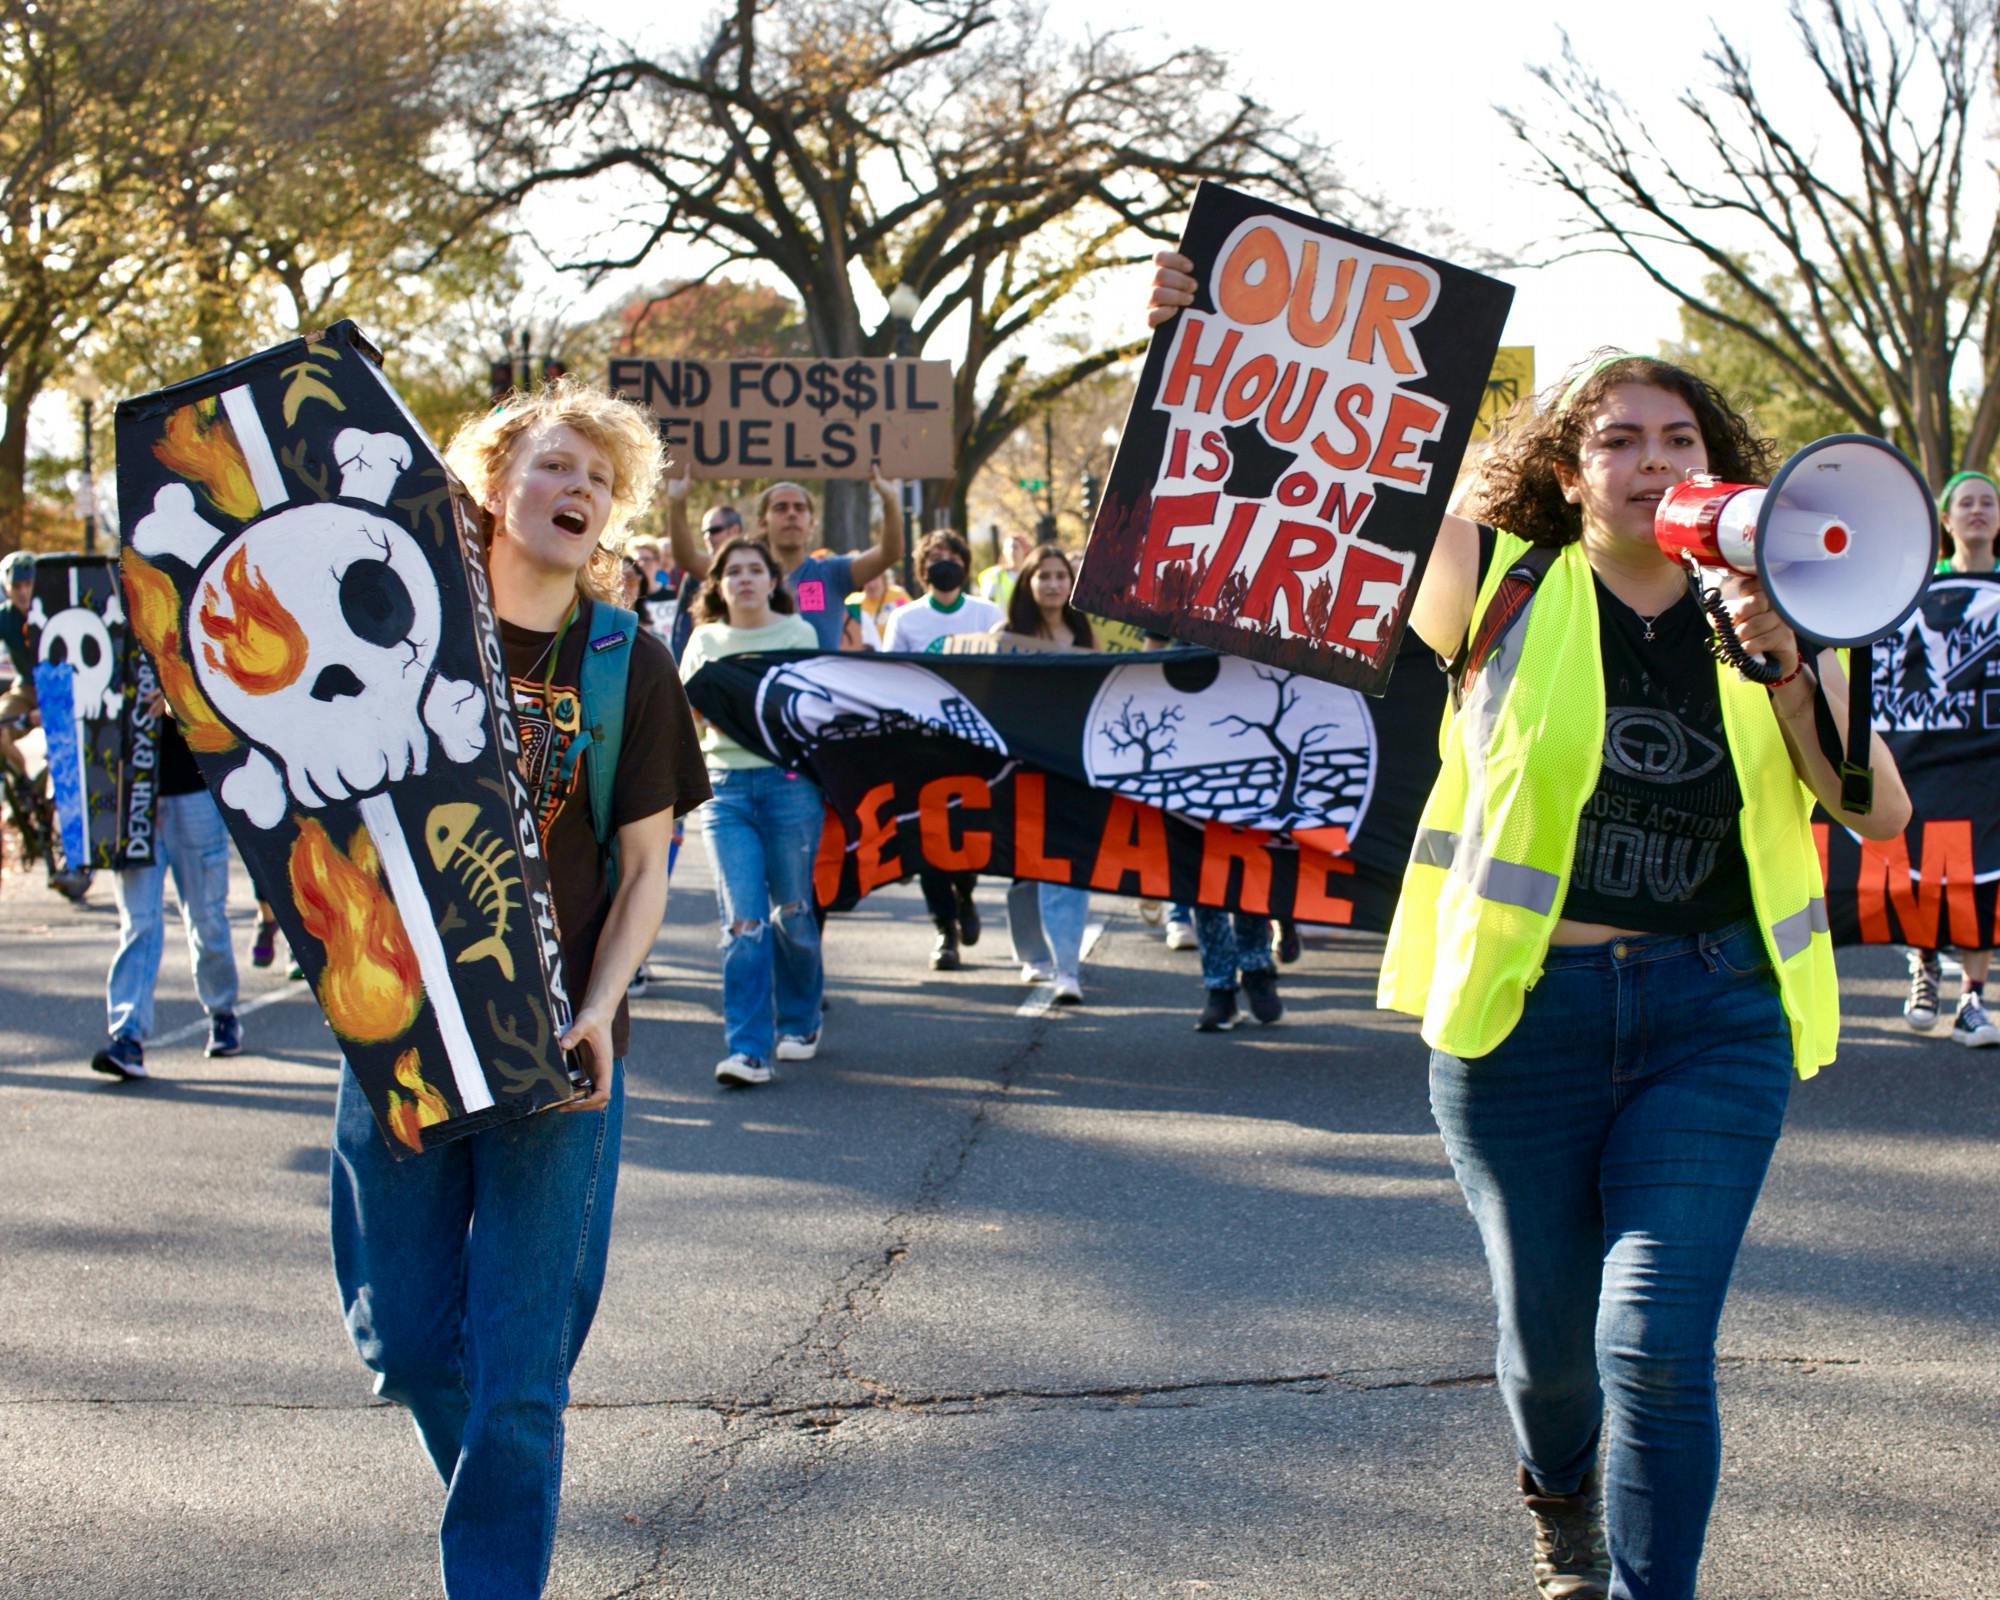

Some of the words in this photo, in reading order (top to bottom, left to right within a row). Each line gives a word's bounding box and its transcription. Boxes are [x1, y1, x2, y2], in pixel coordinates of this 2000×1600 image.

[1218, 225, 1431, 374] OUR
[608, 360, 712, 408] END
[729, 360, 939, 419] FO$$IL
[1161, 318, 1441, 485] HOUSE
[658, 417, 881, 468] FUELS!
[1163, 428, 1230, 483] IS
[1276, 470, 1375, 535] ON
[1134, 490, 1405, 656] FIRE
[458, 501, 519, 755] DROUGHT
[131, 648, 156, 731] STOR
[131, 732, 155, 770] BY
[125, 782, 150, 859] DEATH
[506, 768, 541, 861] BY
[1571, 817, 1721, 903] NOW
